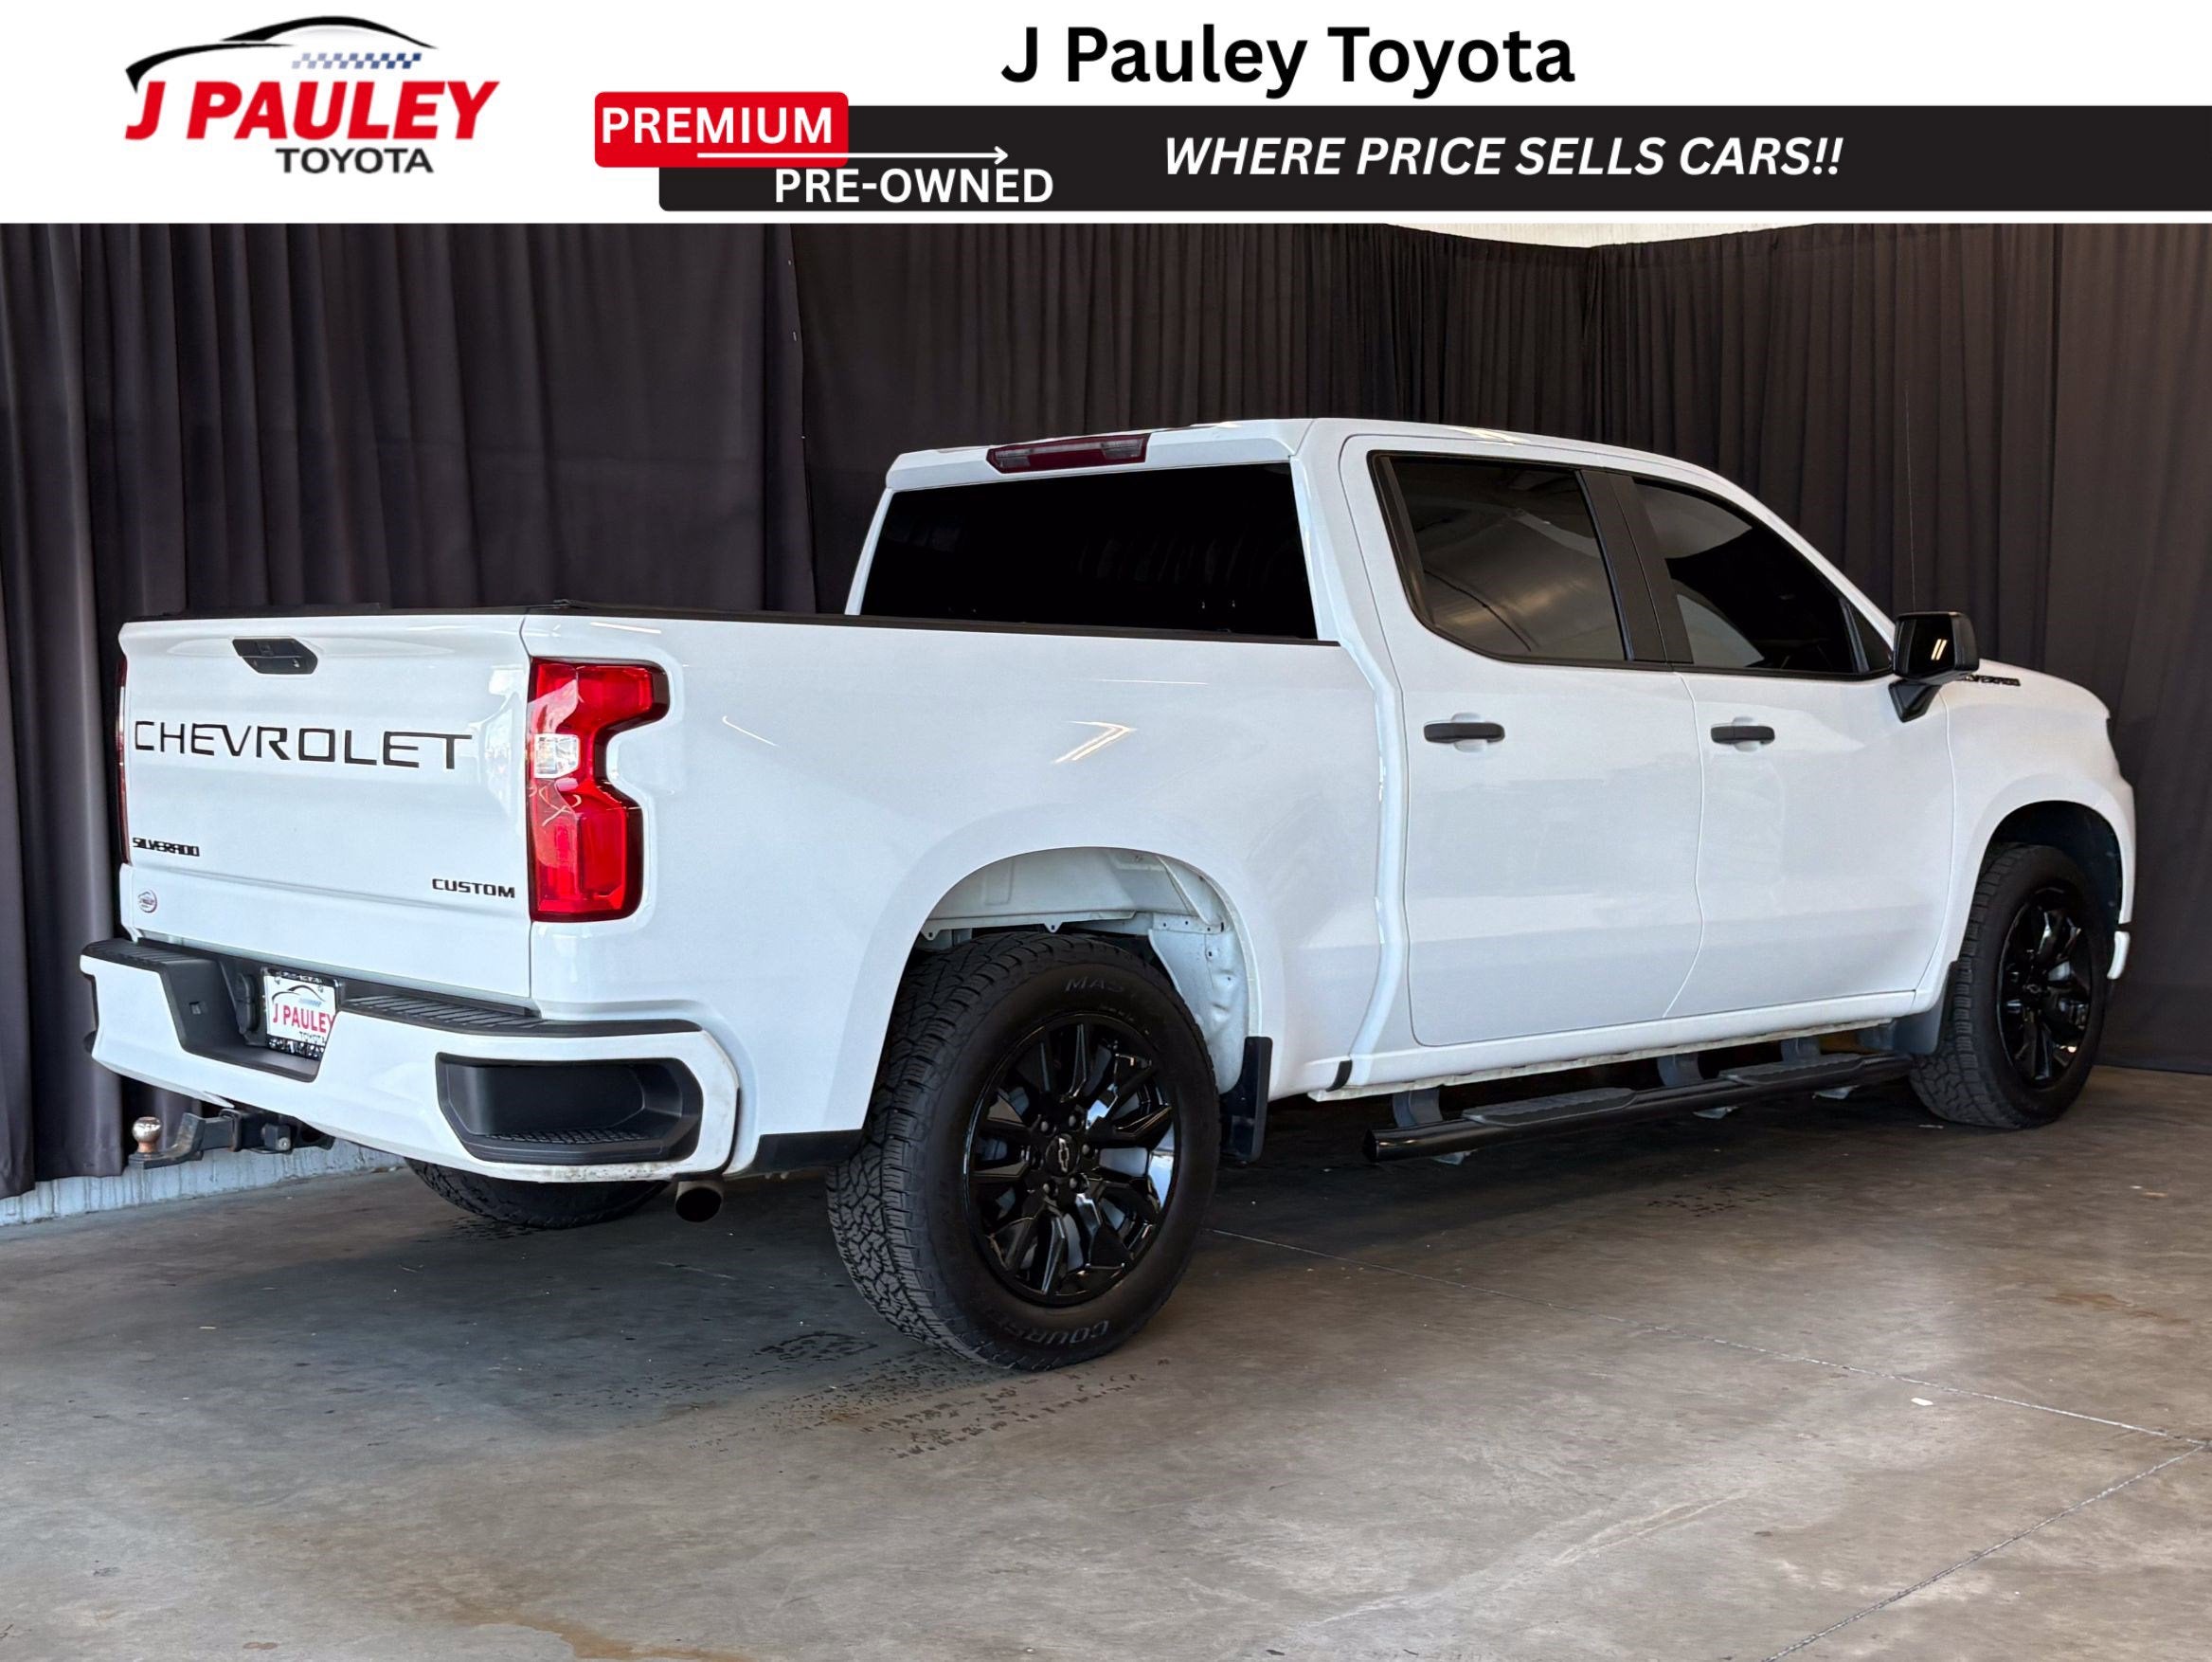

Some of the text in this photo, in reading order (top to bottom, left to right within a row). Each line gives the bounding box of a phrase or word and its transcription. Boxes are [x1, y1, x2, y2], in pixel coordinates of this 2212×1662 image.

[135, 721, 471, 768] CHEVROLET
[132, 837, 200, 858] SILVERADO
[432, 878, 515, 898] CUSTOM
[273, 1003, 279, 1023] J
